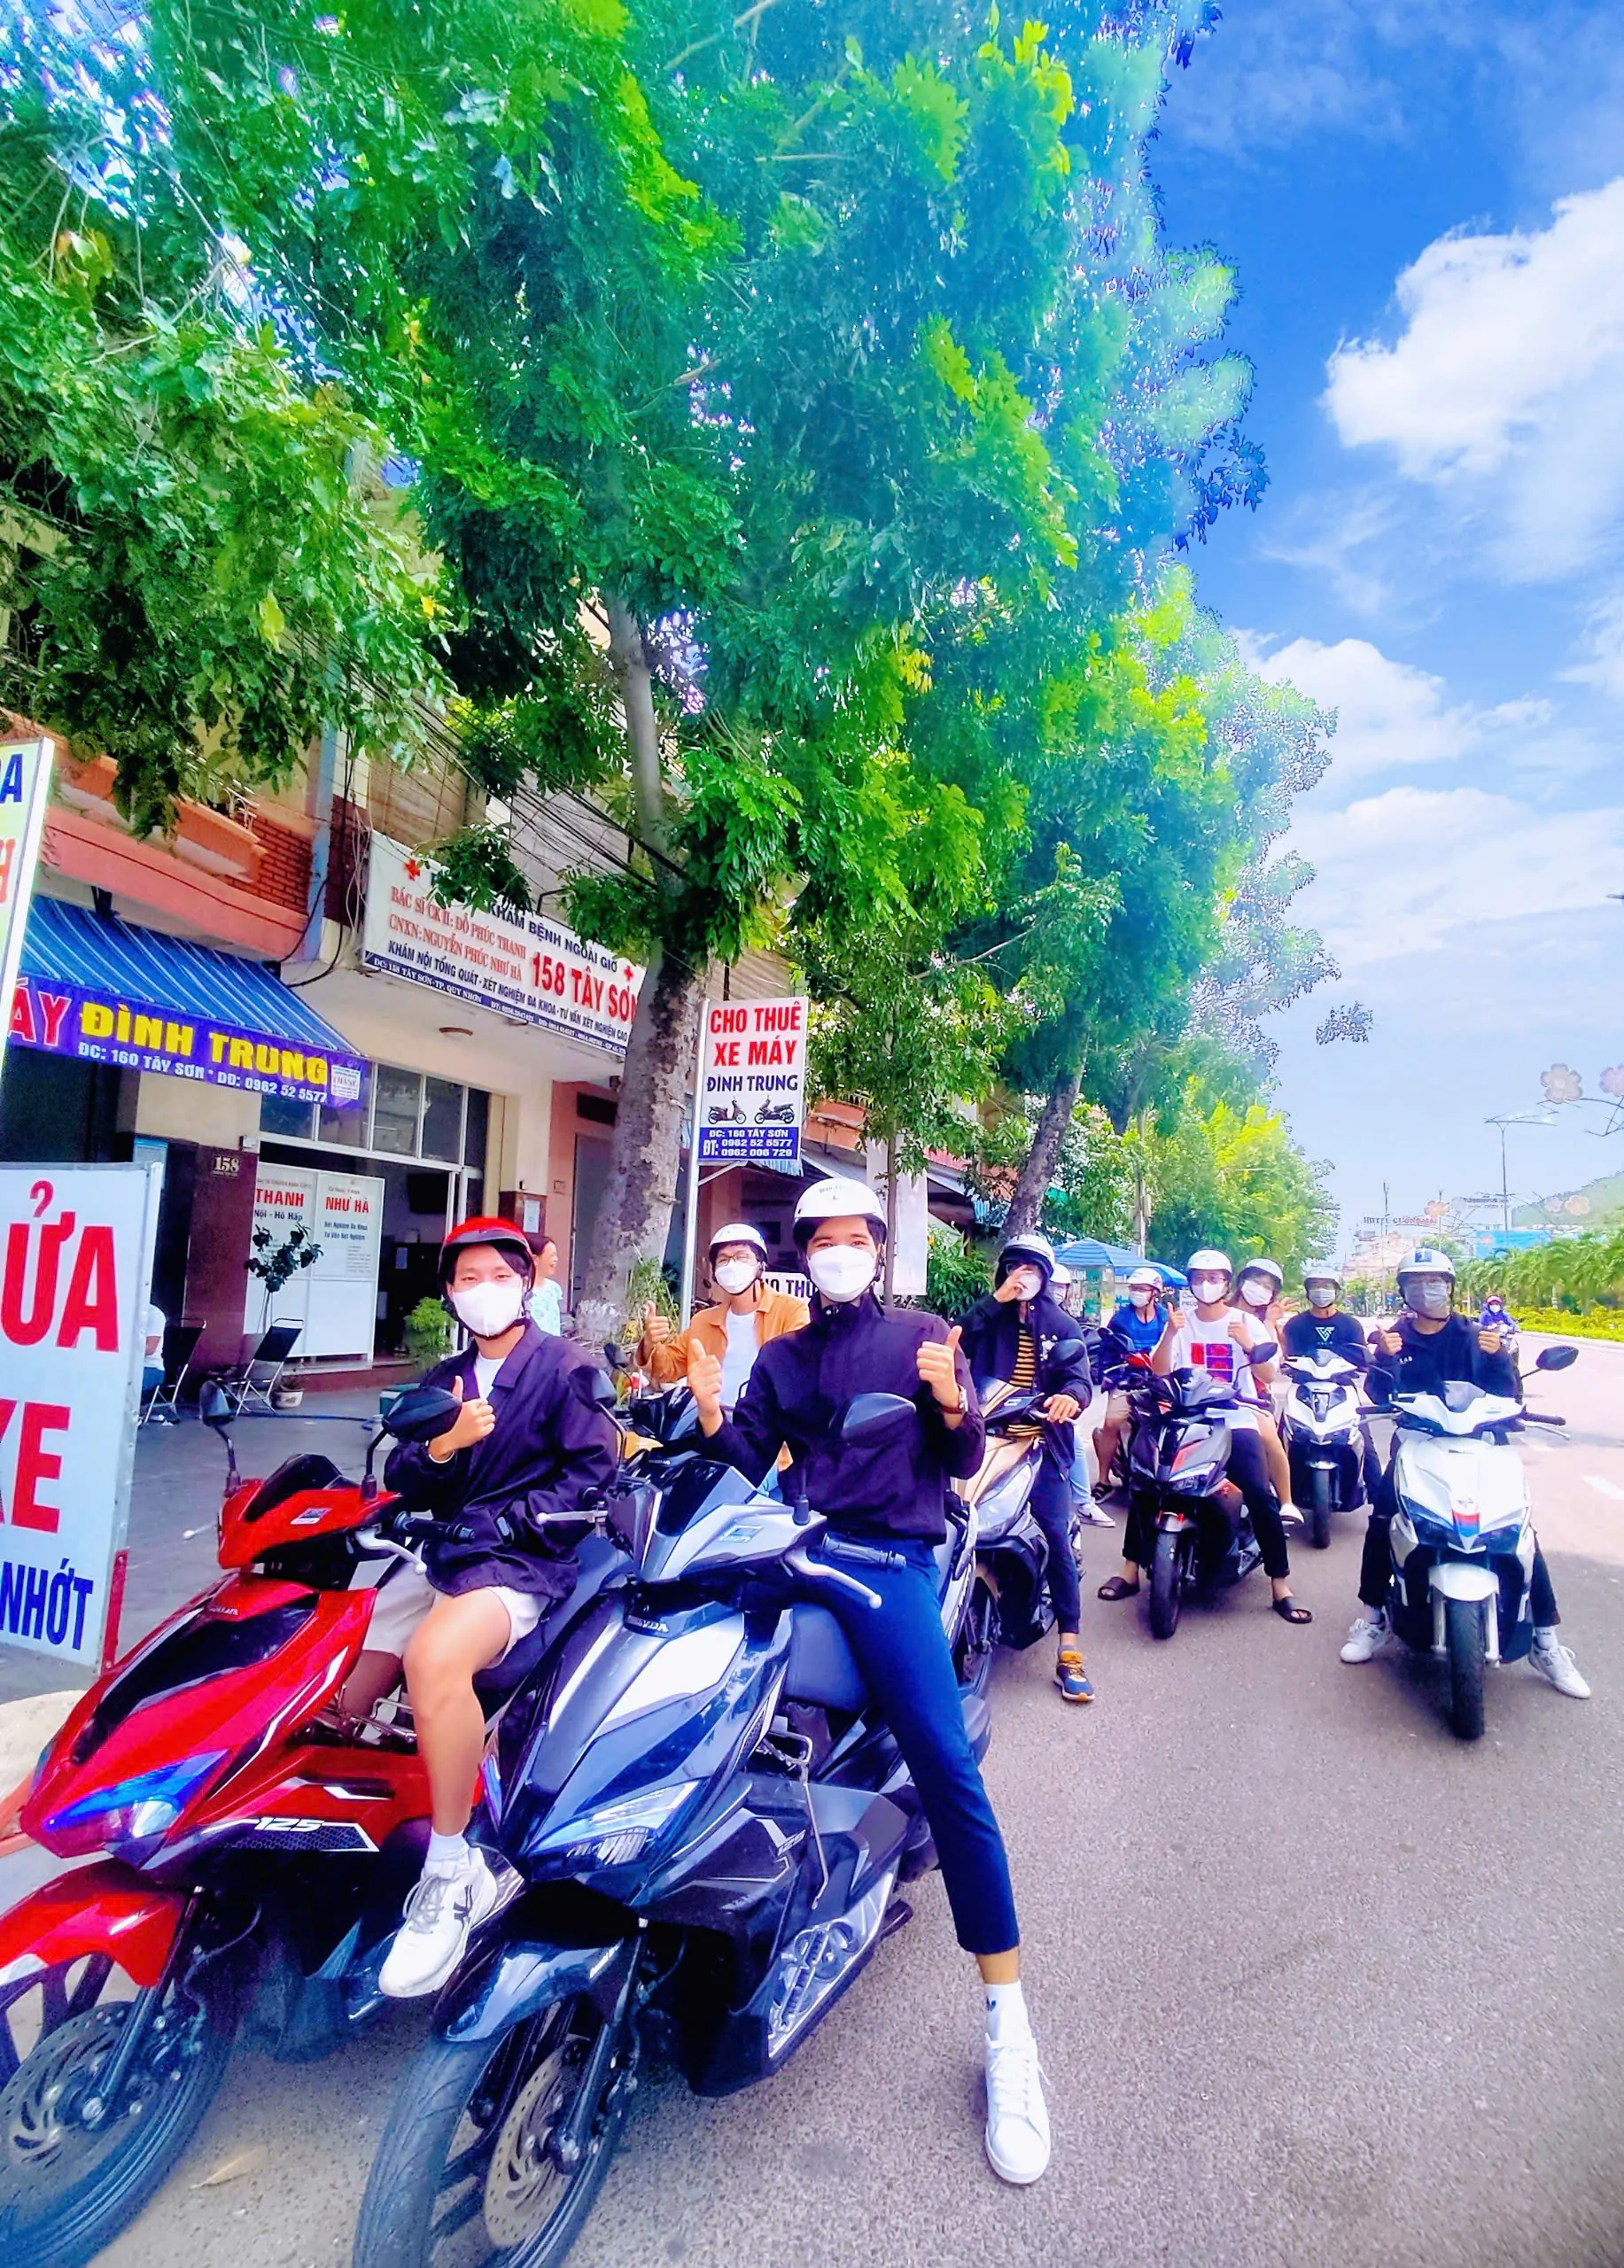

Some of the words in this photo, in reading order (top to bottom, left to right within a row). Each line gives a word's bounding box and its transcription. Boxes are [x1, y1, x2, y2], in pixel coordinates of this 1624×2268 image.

[392, 886, 412, 908] BÁC
[428, 905, 440, 921] CK
[471, 923, 495, 945] PHÚC
[497, 935, 526, 959] THANH
[529, 921, 561, 948] BỆNH
[565, 938, 597, 963] NGOÀI
[465, 945, 488, 967] PHÚC
[511, 964, 522, 981] HÀ
[388, 941, 415, 961] KHÁM
[416, 951, 432, 969] NỘI
[435, 955, 456, 976] TỔNG
[459, 968, 479, 986] QUÁT
[482, 977, 497, 992] XÉT
[498, 983, 525, 1004] NGHIỆM
[539, 999, 556, 1014] KHOA
[582, 1015, 594, 1028] XÉT
[401, 967, 416, 979] TÂY
[447, 984, 462, 995] QUY
[462, 990, 482, 1003] NHƠN
[533, 951, 564, 996] 158
[571, 965, 604, 1012] TÂY
[710, 1008, 747, 1034] CHO
[755, 1001, 801, 1031] THUÊ
[80, 1002, 193, 1056] ĐÌNH
[209, 1032, 328, 1085] TRUNG
[713, 1042, 741, 1066] XE
[748, 1035, 797, 1066] MÁY
[78, 1041, 106, 1060] ĐC:
[111, 1048, 138, 1067] 160
[144, 1053, 171, 1074] TÂY
[175, 1061, 205, 1079] SƠN
[245, 1076, 276, 1095] 0962
[281, 1084, 296, 1099] 52
[299, 1089, 328, 1103] 5577
[706, 1074, 742, 1091] ĐÌNH
[747, 1075, 798, 1091] TRUNG
[748, 1128, 765, 1138] TÂY
[768, 1129, 789, 1138] SƠN
[214, 1156, 239, 1172] 158
[256, 1188, 305, 1208] THANH
[325, 1196, 352, 1212] NHƯ
[288, 1211, 303, 1222] Hấp
[0, 1557, 94, 1651] NHỚT
[254, 1818, 325, 1832] 125
